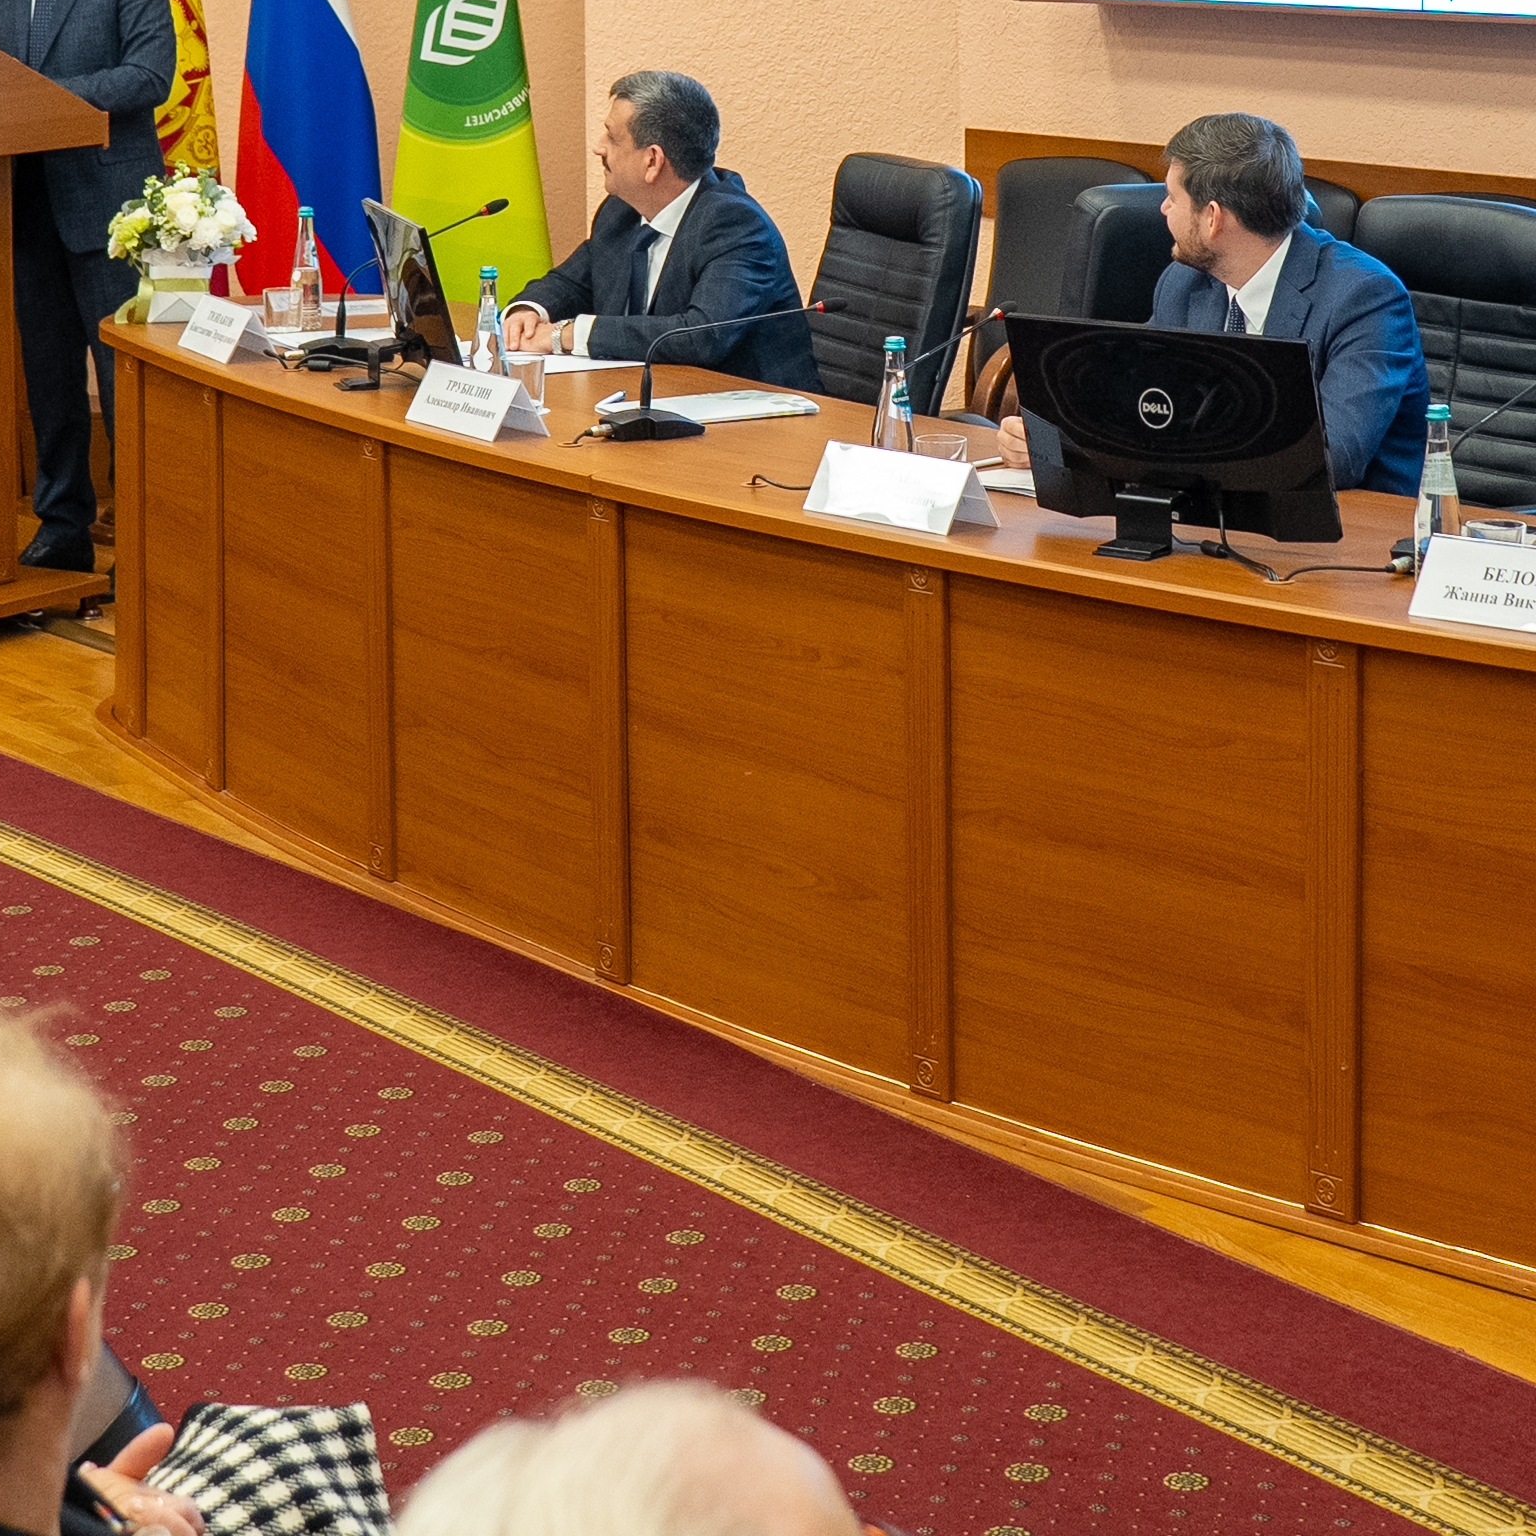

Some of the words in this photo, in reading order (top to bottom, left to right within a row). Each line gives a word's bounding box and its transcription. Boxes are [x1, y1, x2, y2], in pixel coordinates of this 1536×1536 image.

[446, 380, 492, 400] ТРУБИЛИН
[425, 394, 460, 413] Александр
[460, 402, 496, 420] Иванович
[1142, 402, 1170, 414] DELL
[1443, 584, 1498, 605] Жанна
